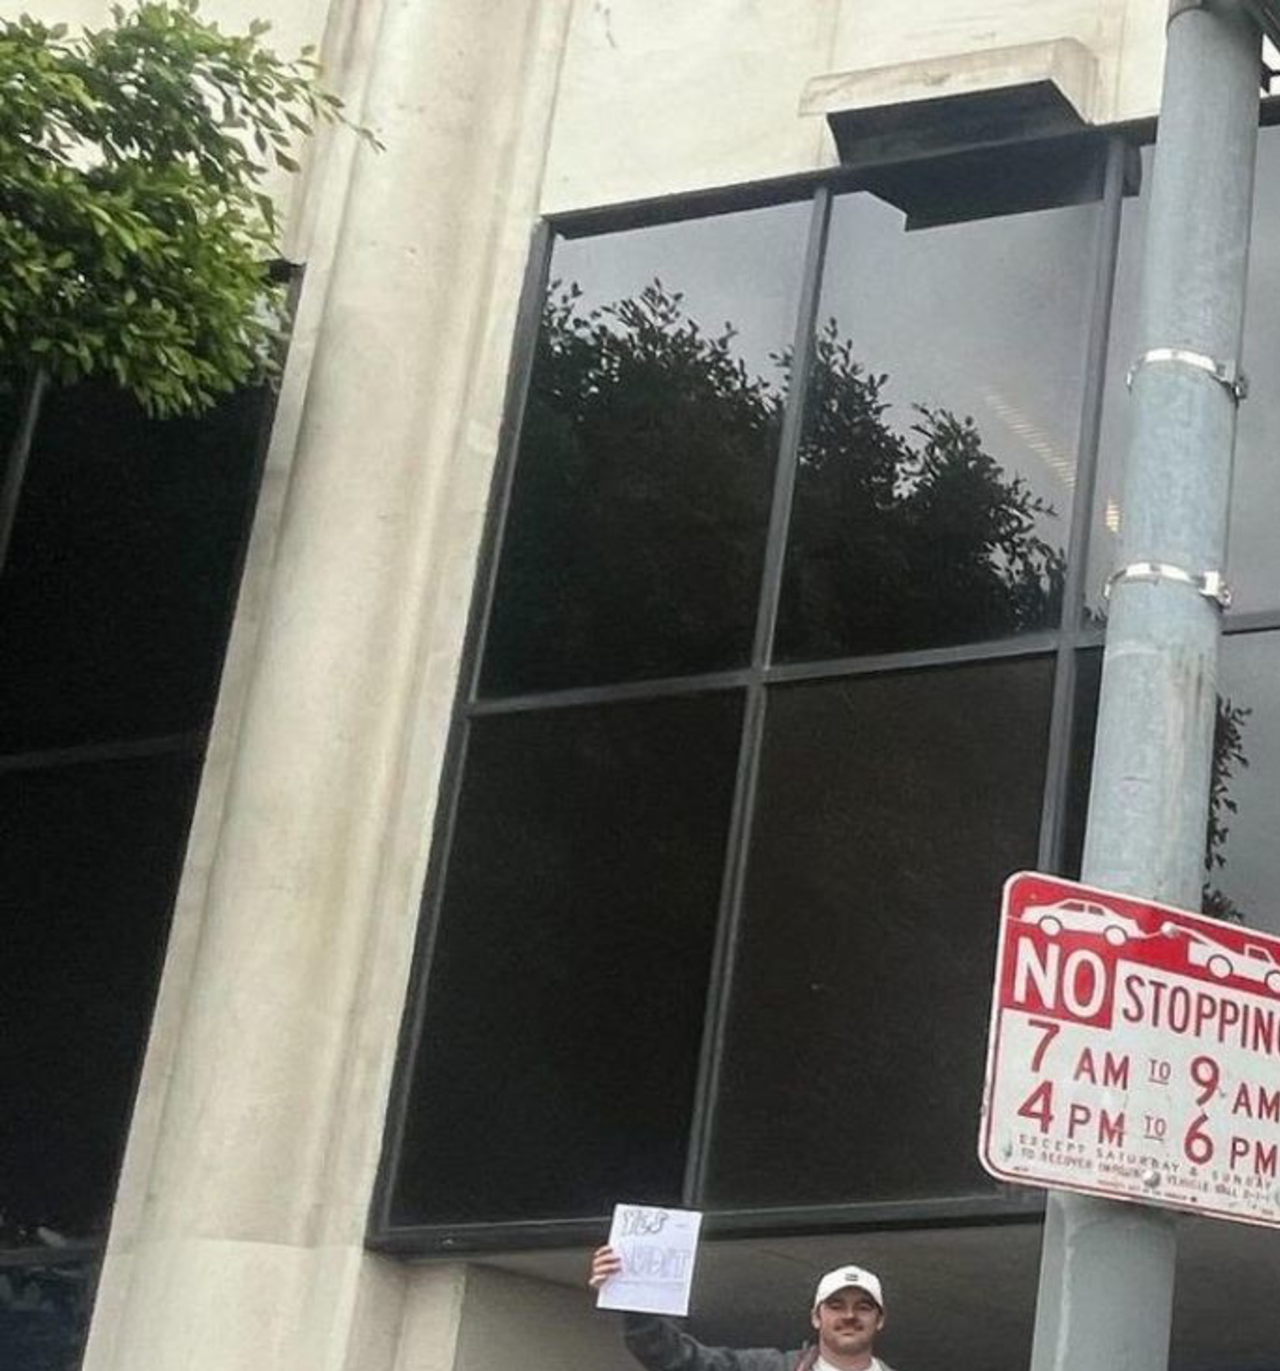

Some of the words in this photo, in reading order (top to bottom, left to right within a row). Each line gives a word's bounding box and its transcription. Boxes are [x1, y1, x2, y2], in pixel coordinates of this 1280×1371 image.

[1013, 936, 1107, 1019] NO
[1028, 1019, 1060, 1073] 7
[1074, 1048, 1130, 1091] AM
[1149, 1060, 1171, 1081] TO
[1190, 1056, 1220, 1107] 9
[1232, 1083, 1280, 1123] AM
[1017, 1080, 1054, 1134] 4
[1067, 1104, 1126, 1148] PM
[1144, 1116, 1167, 1137] TO
[1184, 1113, 1214, 1165] 6
[1229, 1138, 1278, 1178] PM
[1018, 1134, 1086, 1154] EXCEPT
[1096, 1148, 1180, 1173] SATURDAY
[1212, 1170, 1272, 1190] SUNDAY
